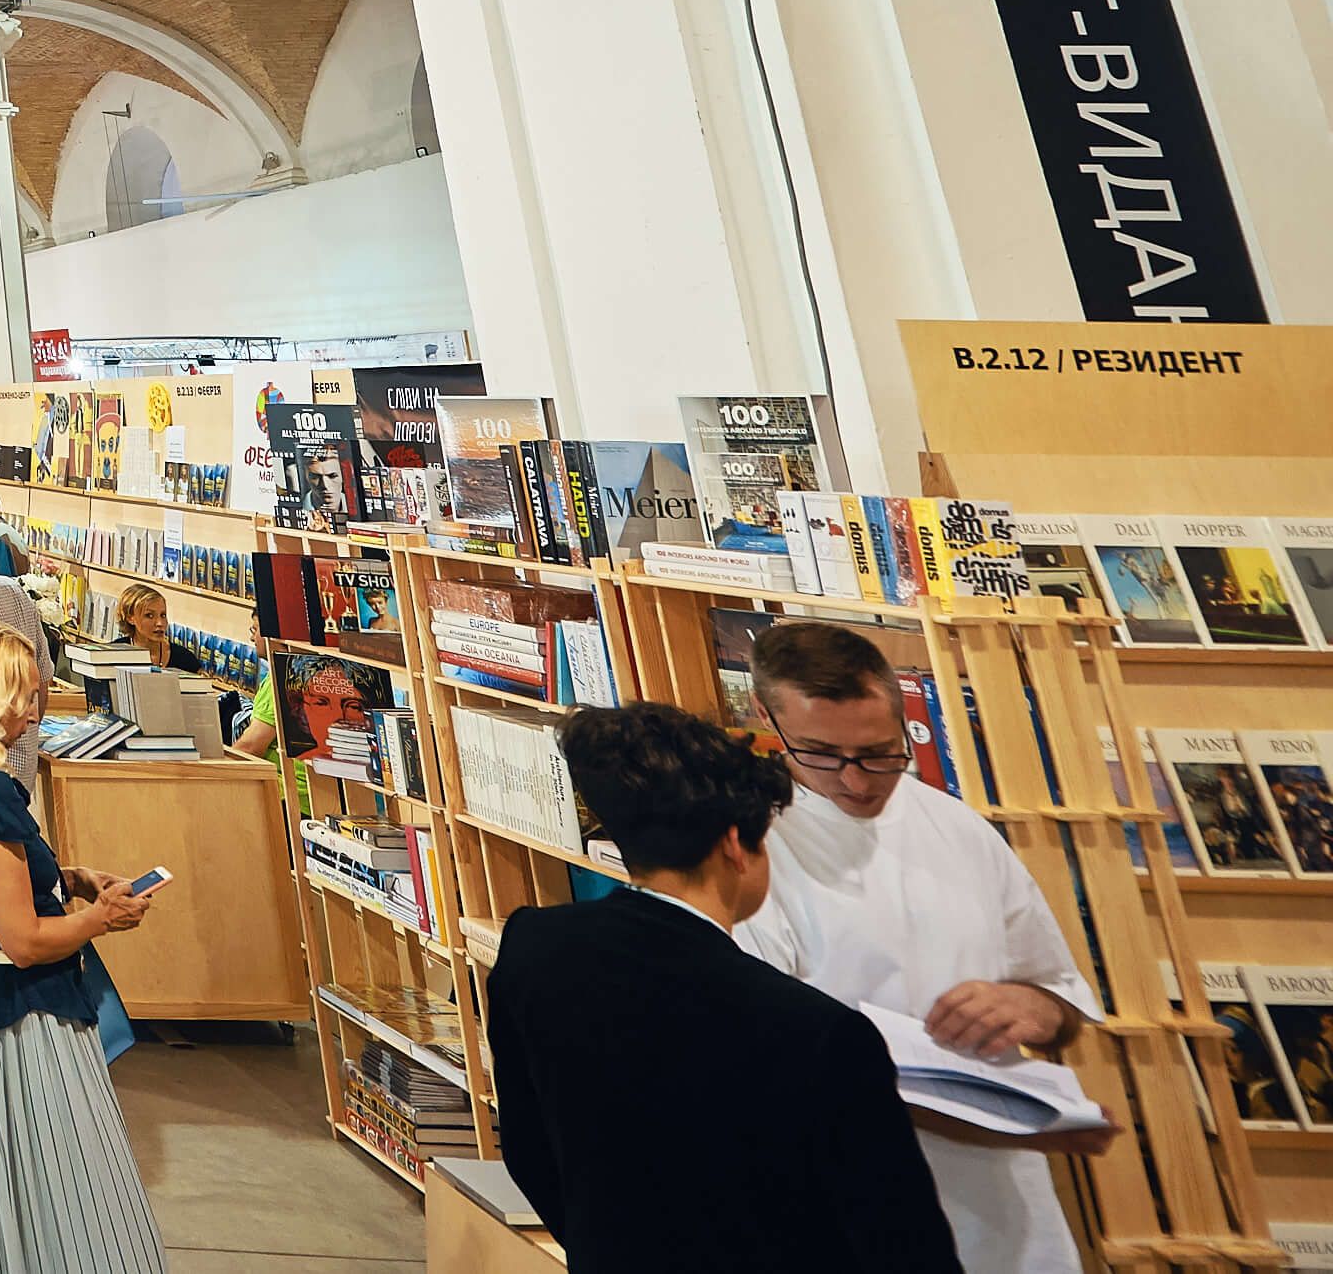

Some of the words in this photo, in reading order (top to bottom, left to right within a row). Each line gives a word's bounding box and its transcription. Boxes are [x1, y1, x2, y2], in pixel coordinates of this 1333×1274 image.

[1073, 348, 1243, 377] РЕЗИДЕНТ
[197, 385, 222, 396] ФЕЄРІЯ
[388, 387, 421, 410] СЛІДИ
[292, 412, 326, 431] 100
[719, 405, 769, 426] 100
[394, 421, 436, 444] ДОРОЗІ
[474, 418, 512, 439] 100
[730, 427, 763, 435] AROUND
[722, 462, 756, 476] 100
[524, 456, 549, 547] CALATRAVA
[569, 471, 590, 538] HADID
[587, 486, 600, 519] Meier
[602, 486, 698, 519] Meier
[978, 508, 1010, 516] domus
[1183, 523, 1247, 537] HOPPER
[849, 521, 870, 575] domus
[918, 525, 940, 582] domus
[694, 554, 718, 563] AROUND
[730, 558, 750, 566] WORLD
[335, 574, 356, 586] TV
[469, 618, 501, 633] EUROPE
[461, 644, 478, 656] ASIA
[484, 649, 521, 665] OCEANIA
[312, 676, 354, 687] RECORD
[323, 669, 342, 679] ART
[313, 685, 355, 696] COVERS
[1184, 737, 1239, 752] MANET
[554, 755, 565, 802] Architecture
[359, 886, 375, 900] World
